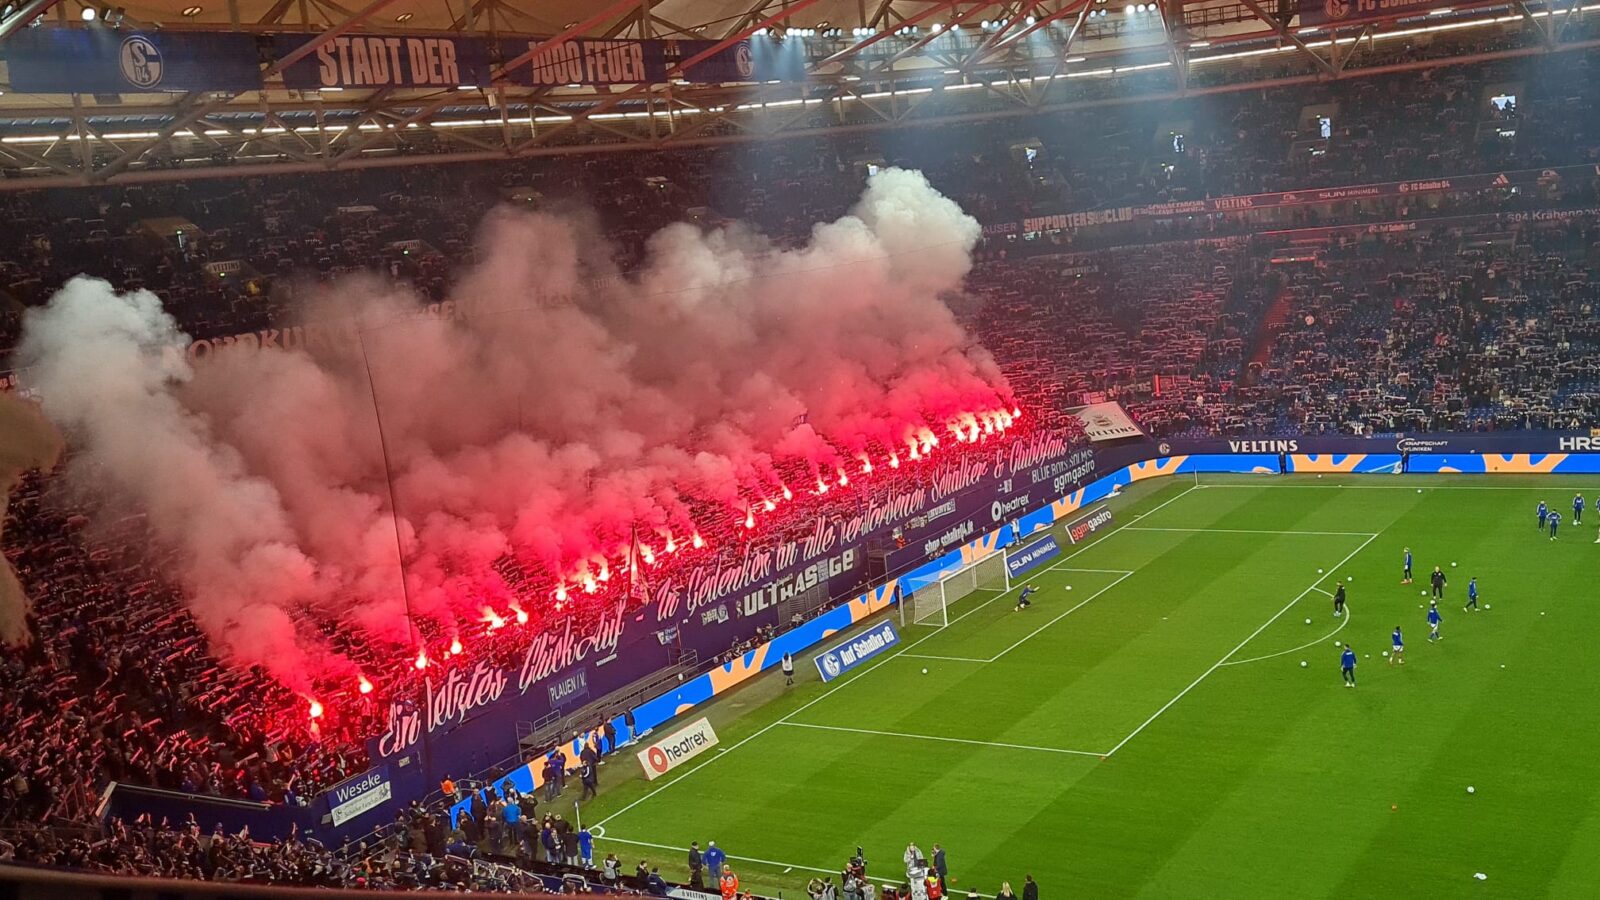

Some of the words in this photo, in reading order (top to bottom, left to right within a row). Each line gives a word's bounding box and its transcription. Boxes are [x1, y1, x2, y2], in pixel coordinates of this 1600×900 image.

[317, 37, 402, 86] STADT
[407, 38, 460, 84] DER
[528, 41, 583, 84] 1000
[584, 41, 646, 82] FEUER
[1215, 197, 1253, 210] VELTINS
[1319, 191, 1346, 199] SUN
[1024, 211, 1094, 232] SUPPORTERS
[1106, 207, 1132, 223] CLUB
[1088, 426, 1136, 437] VELTINS
[1228, 440, 1298, 453] VELTINS
[1560, 436, 1600, 450] HRS
[1031, 465, 1050, 483] BLUE
[1002, 494, 1030, 515] heatrex
[1009, 554, 1033, 571] SUN
[379, 702, 421, 757] Ein
[425, 659, 508, 733] letztes
[519, 615, 577, 696] Glück
[576, 597, 626, 660] Auf
[687, 543, 772, 617] Gedenken
[803, 516, 836, 561] alle
[932, 454, 988, 503] Schalker
[840, 645, 857, 666] Auf
[853, 634, 885, 659] Schalke
[881, 626, 895, 643] eG
[550, 677, 577, 701] PLAUEN
[664, 730, 708, 762] heatrex
[336, 774, 381, 803] Weseke
